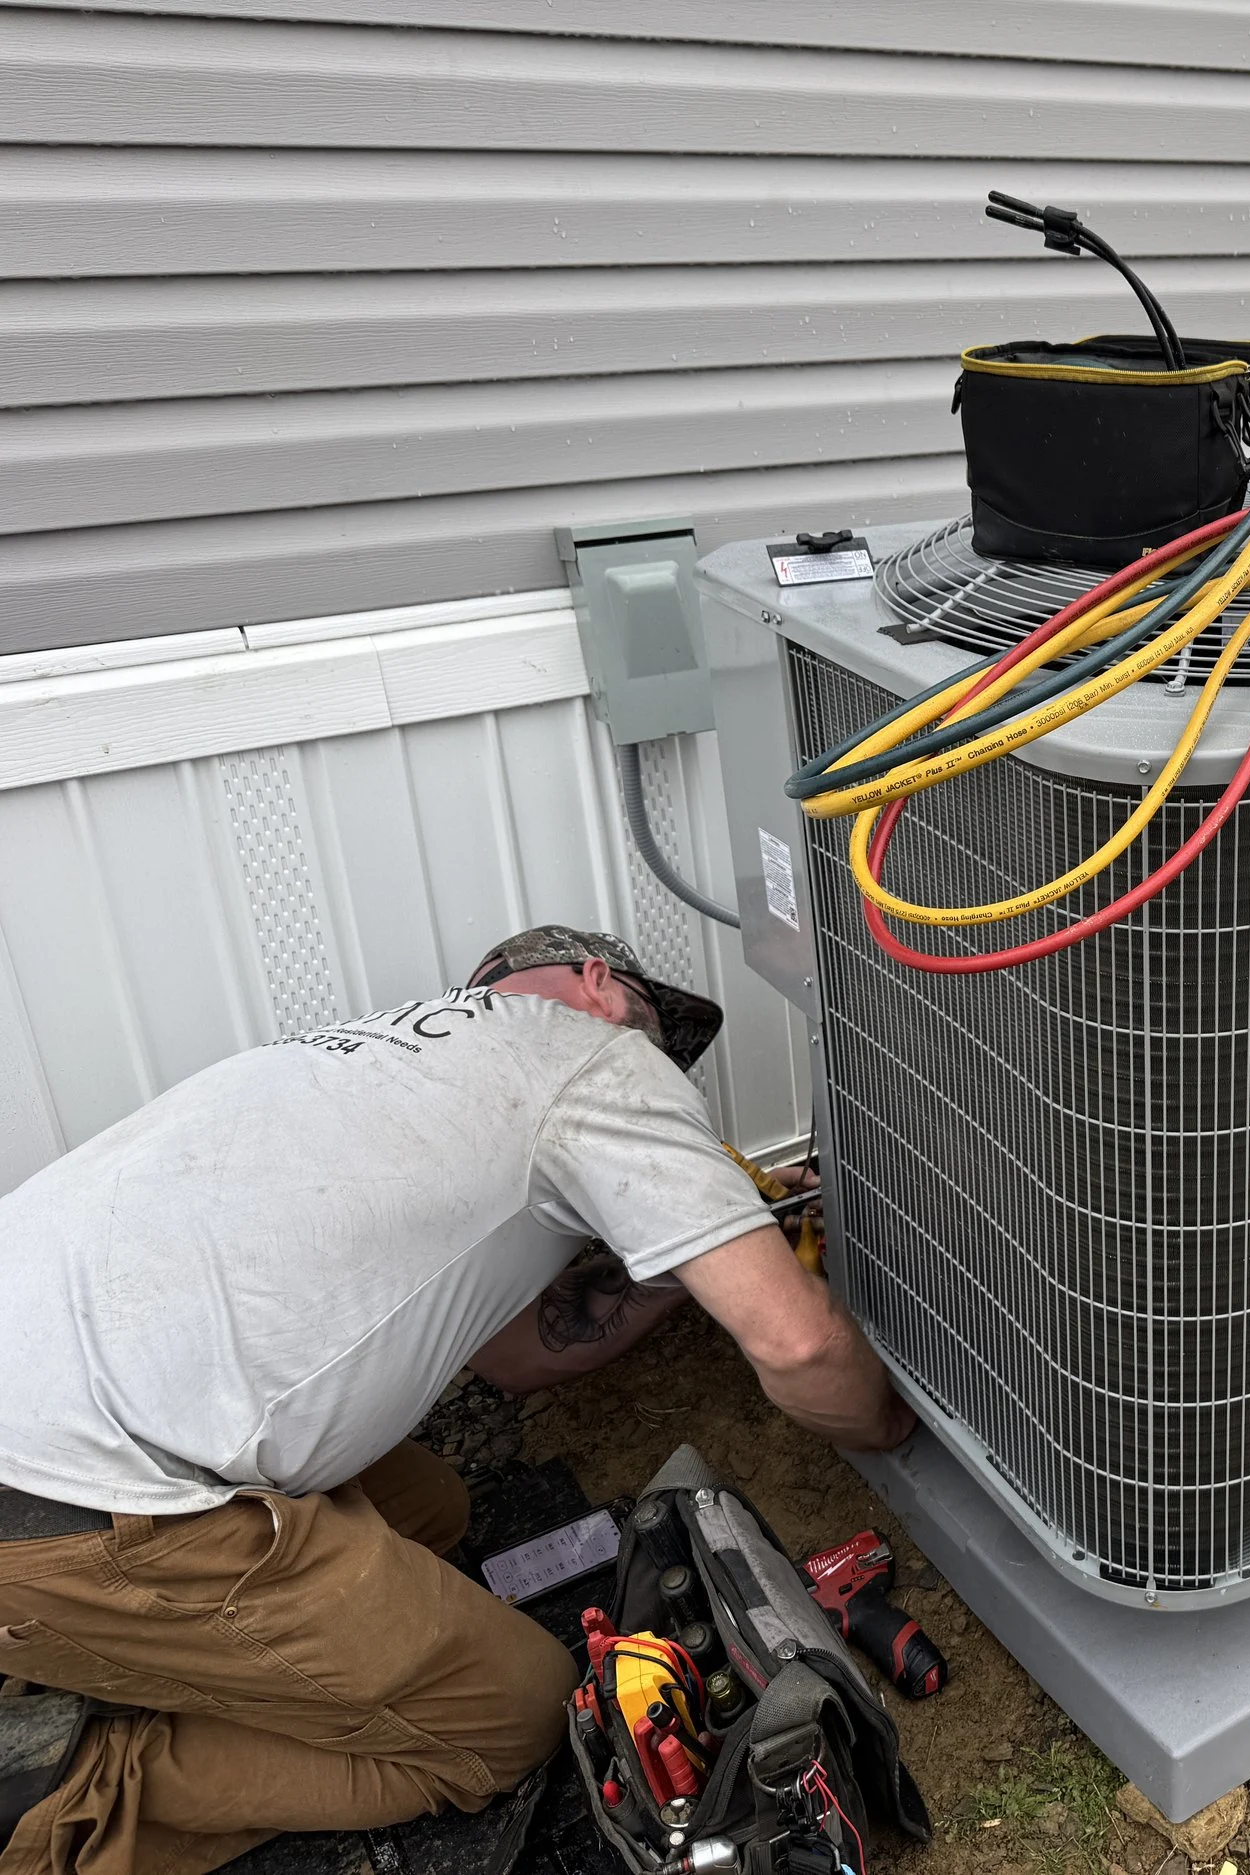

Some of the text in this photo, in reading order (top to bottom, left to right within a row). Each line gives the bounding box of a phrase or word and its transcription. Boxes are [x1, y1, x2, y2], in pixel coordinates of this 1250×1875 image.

[851, 787, 882, 805] YELLOW
[925, 765, 943, 778] Plus
[1006, 724, 1028, 743] Hose
[1035, 707, 1066, 728] 3000psi
[1084, 687, 1100, 703] Bar)
[1114, 671, 1131, 684] burst
[1063, 871, 1090, 889] YELLOW
[1016, 900, 1031, 910] Plus
[941, 914, 960, 923] Hose
[960, 911, 993, 922] Charging
[333, 1027, 423, 1055] Residential Needs
